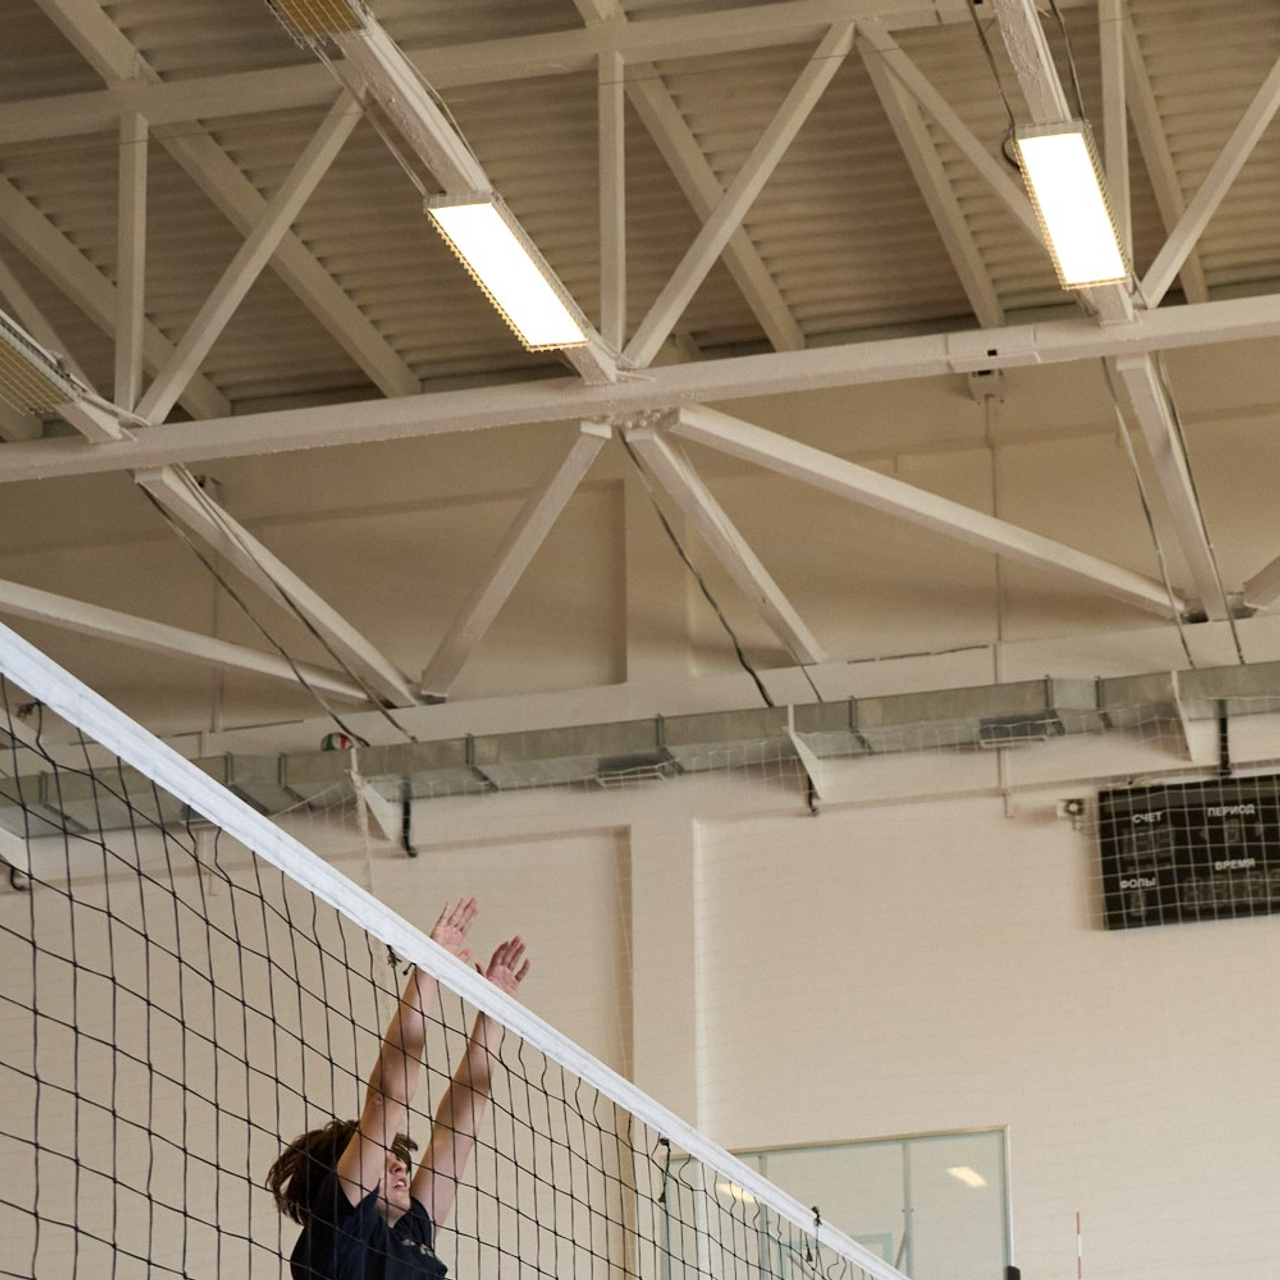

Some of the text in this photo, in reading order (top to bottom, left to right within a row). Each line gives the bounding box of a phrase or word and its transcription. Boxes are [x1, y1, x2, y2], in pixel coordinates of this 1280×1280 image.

[1208, 804, 1255, 817] ПЕРИОД
[1131, 811, 1163, 824] СЧЕТ
[1215, 858, 1255, 870] ВРЕМЯ
[1119, 877, 1156, 889] ФОЛЫ
